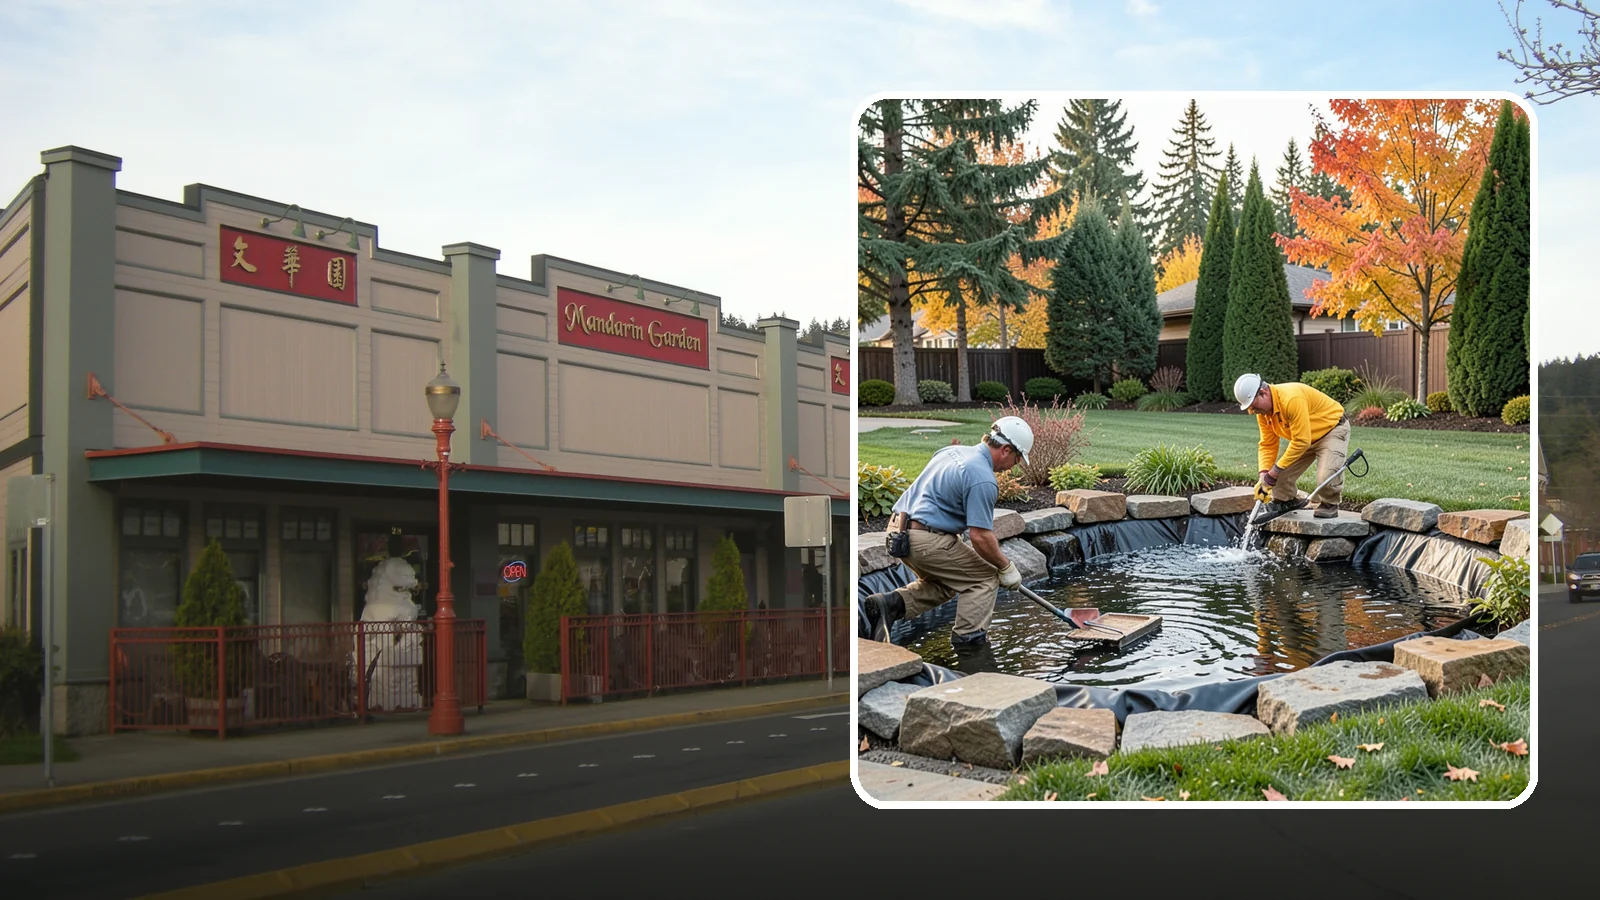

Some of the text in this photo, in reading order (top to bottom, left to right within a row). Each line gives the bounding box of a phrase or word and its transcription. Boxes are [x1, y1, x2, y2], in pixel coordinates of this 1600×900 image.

[230, 235, 346, 291] 文華園
[564, 302, 701, 352] Mandarin Garden
[503, 565, 527, 578] OPEN
